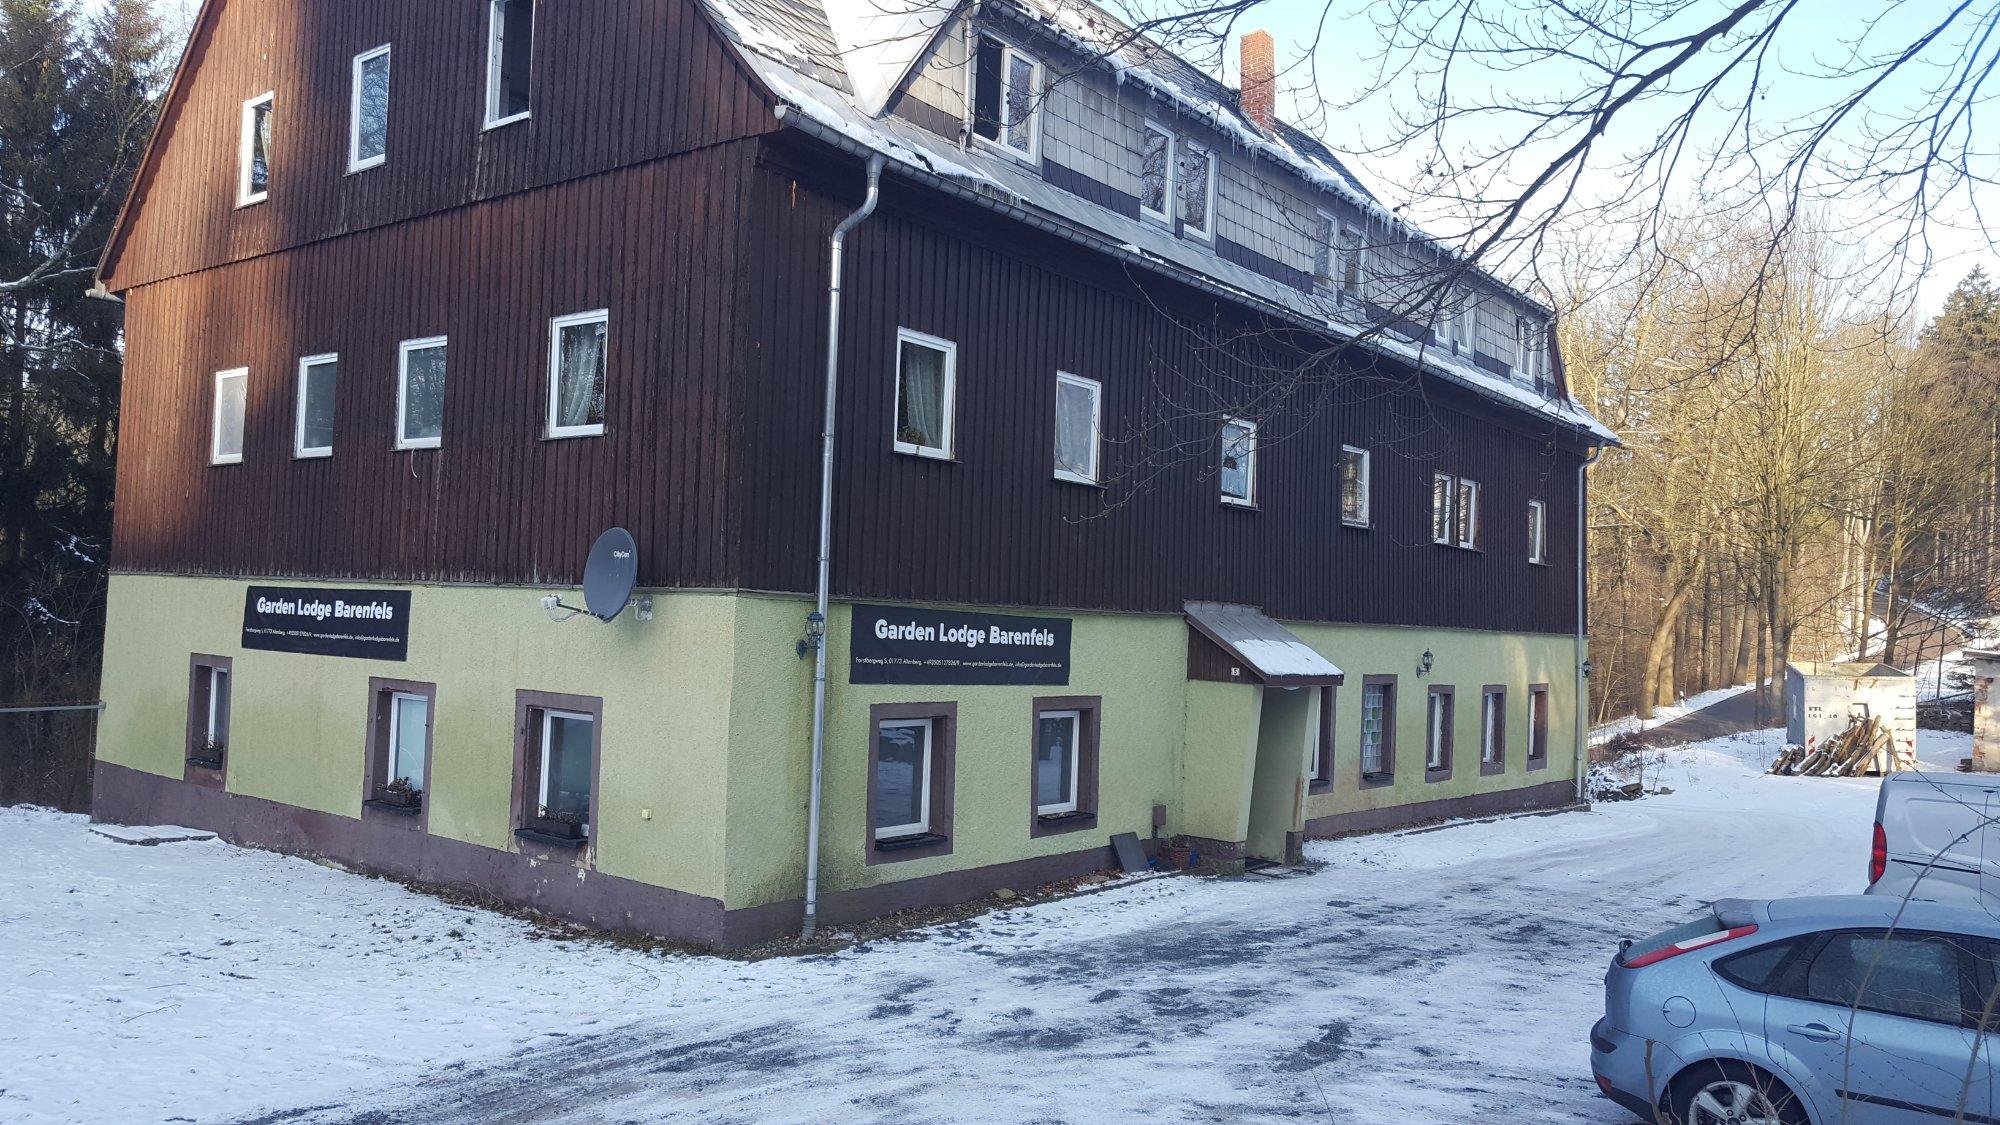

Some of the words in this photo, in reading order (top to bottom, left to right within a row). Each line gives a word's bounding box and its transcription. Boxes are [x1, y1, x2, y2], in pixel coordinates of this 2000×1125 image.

[256, 596, 296, 615] Garden
[297, 598, 332, 621] Lodge
[334, 600, 393, 619] Barenfels
[875, 618, 935, 641] Garden
[939, 622, 986, 648] Lodge
[989, 625, 1055, 646] Barenfels
